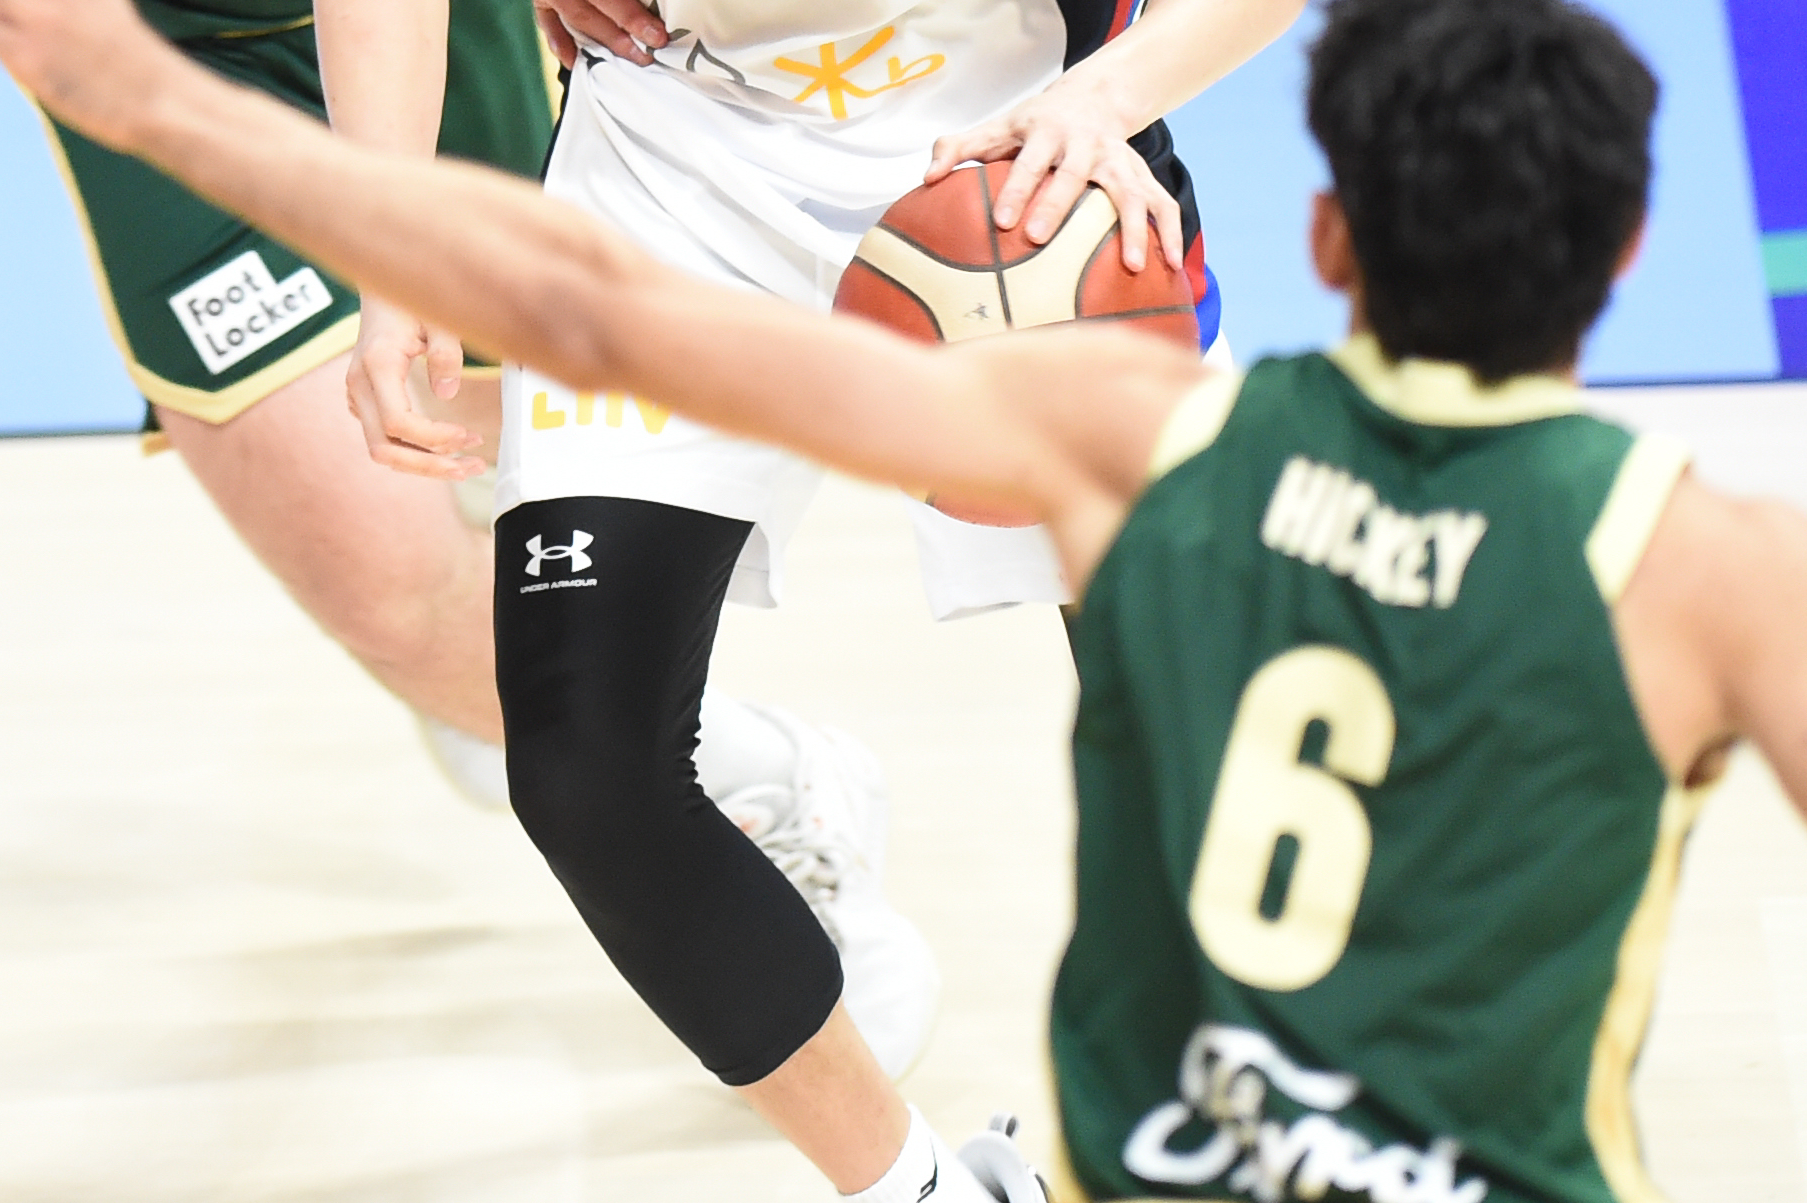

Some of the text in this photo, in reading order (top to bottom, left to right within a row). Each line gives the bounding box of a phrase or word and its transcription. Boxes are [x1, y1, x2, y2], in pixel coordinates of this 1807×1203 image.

[187, 271, 262, 327] Foot
[204, 283, 313, 356] Locker
[1189, 643, 1397, 993] 6
